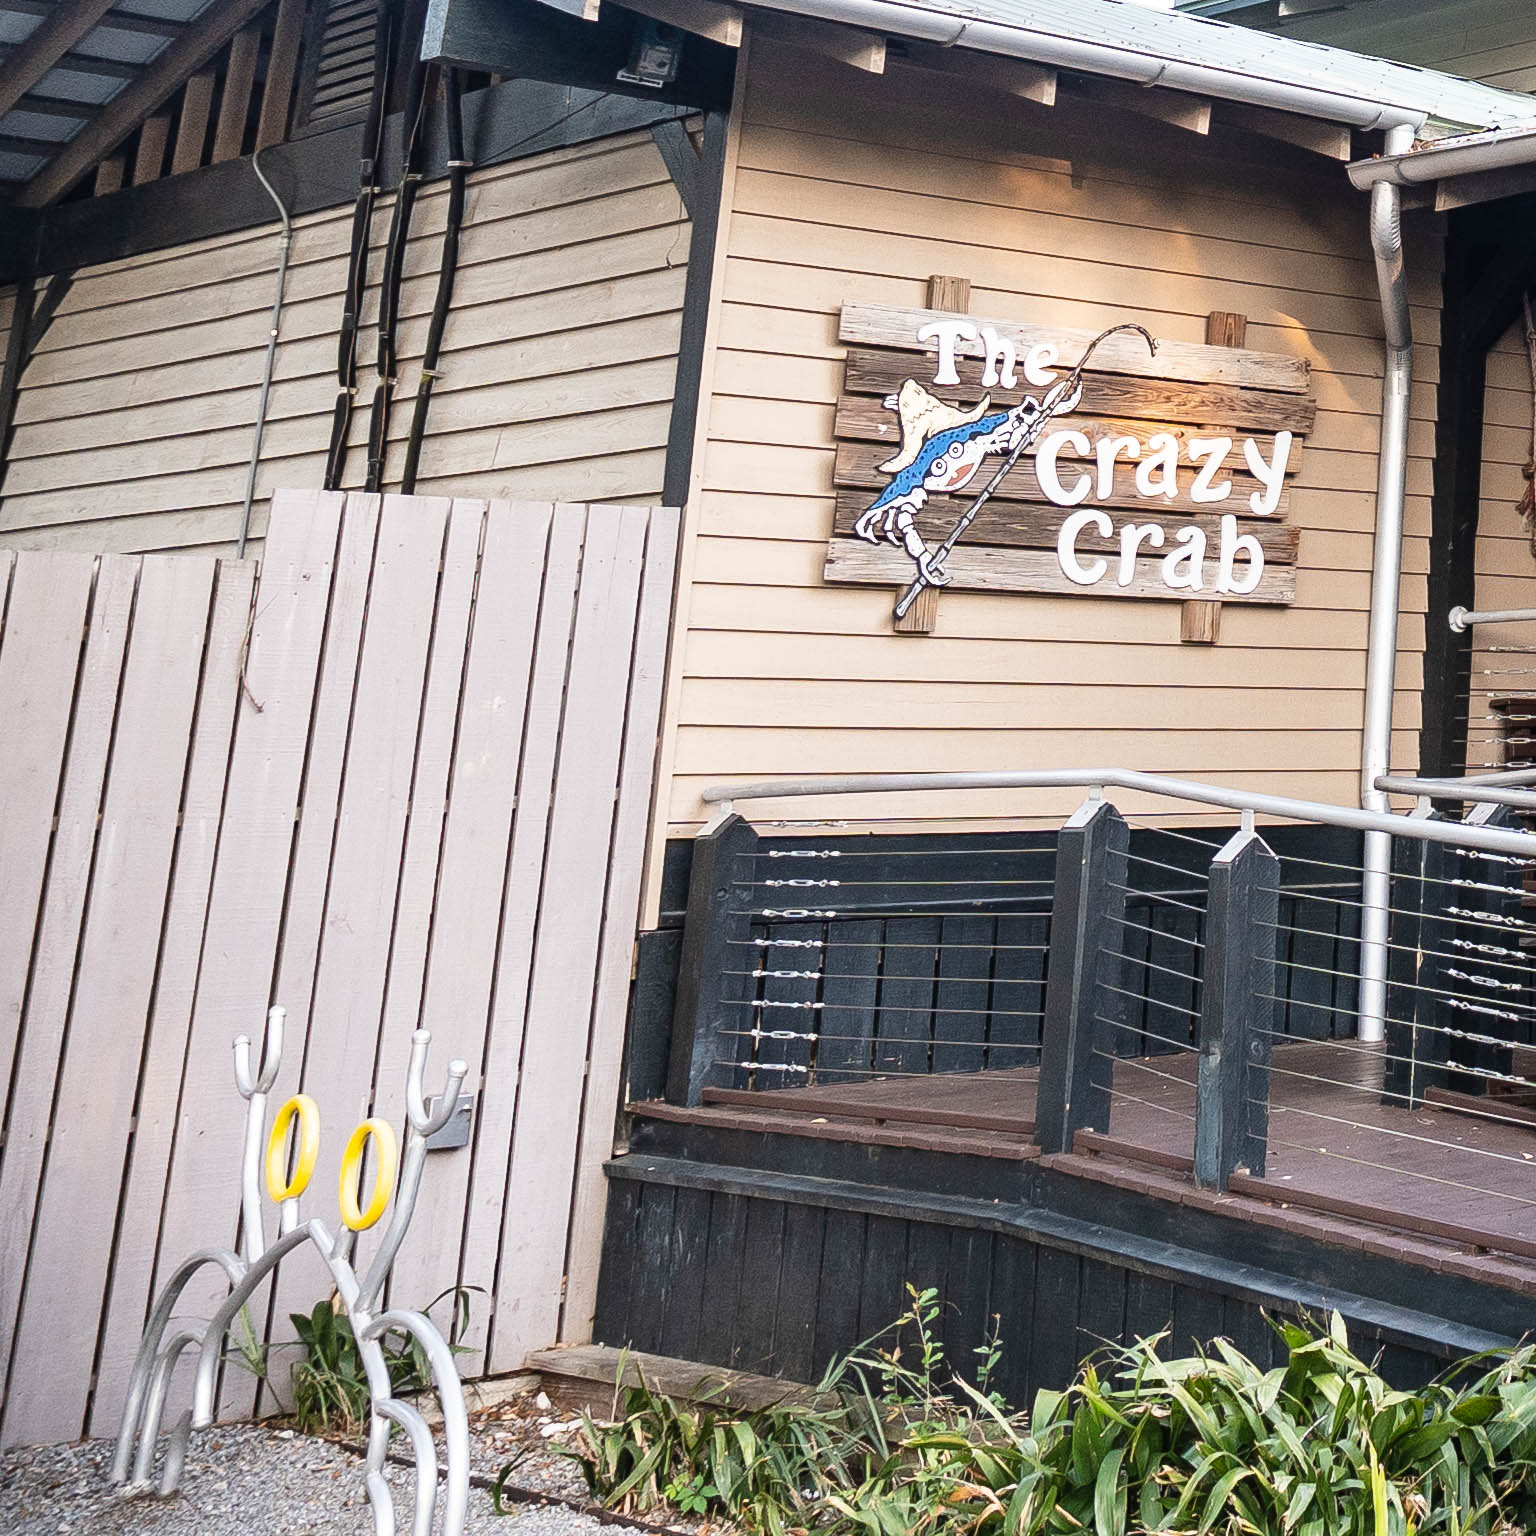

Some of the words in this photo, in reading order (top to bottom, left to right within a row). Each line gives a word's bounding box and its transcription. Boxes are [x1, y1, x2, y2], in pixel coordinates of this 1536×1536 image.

[916, 320, 1061, 389] The
[1035, 430, 1293, 517] Crazy
[1057, 509, 1265, 595] Crab
